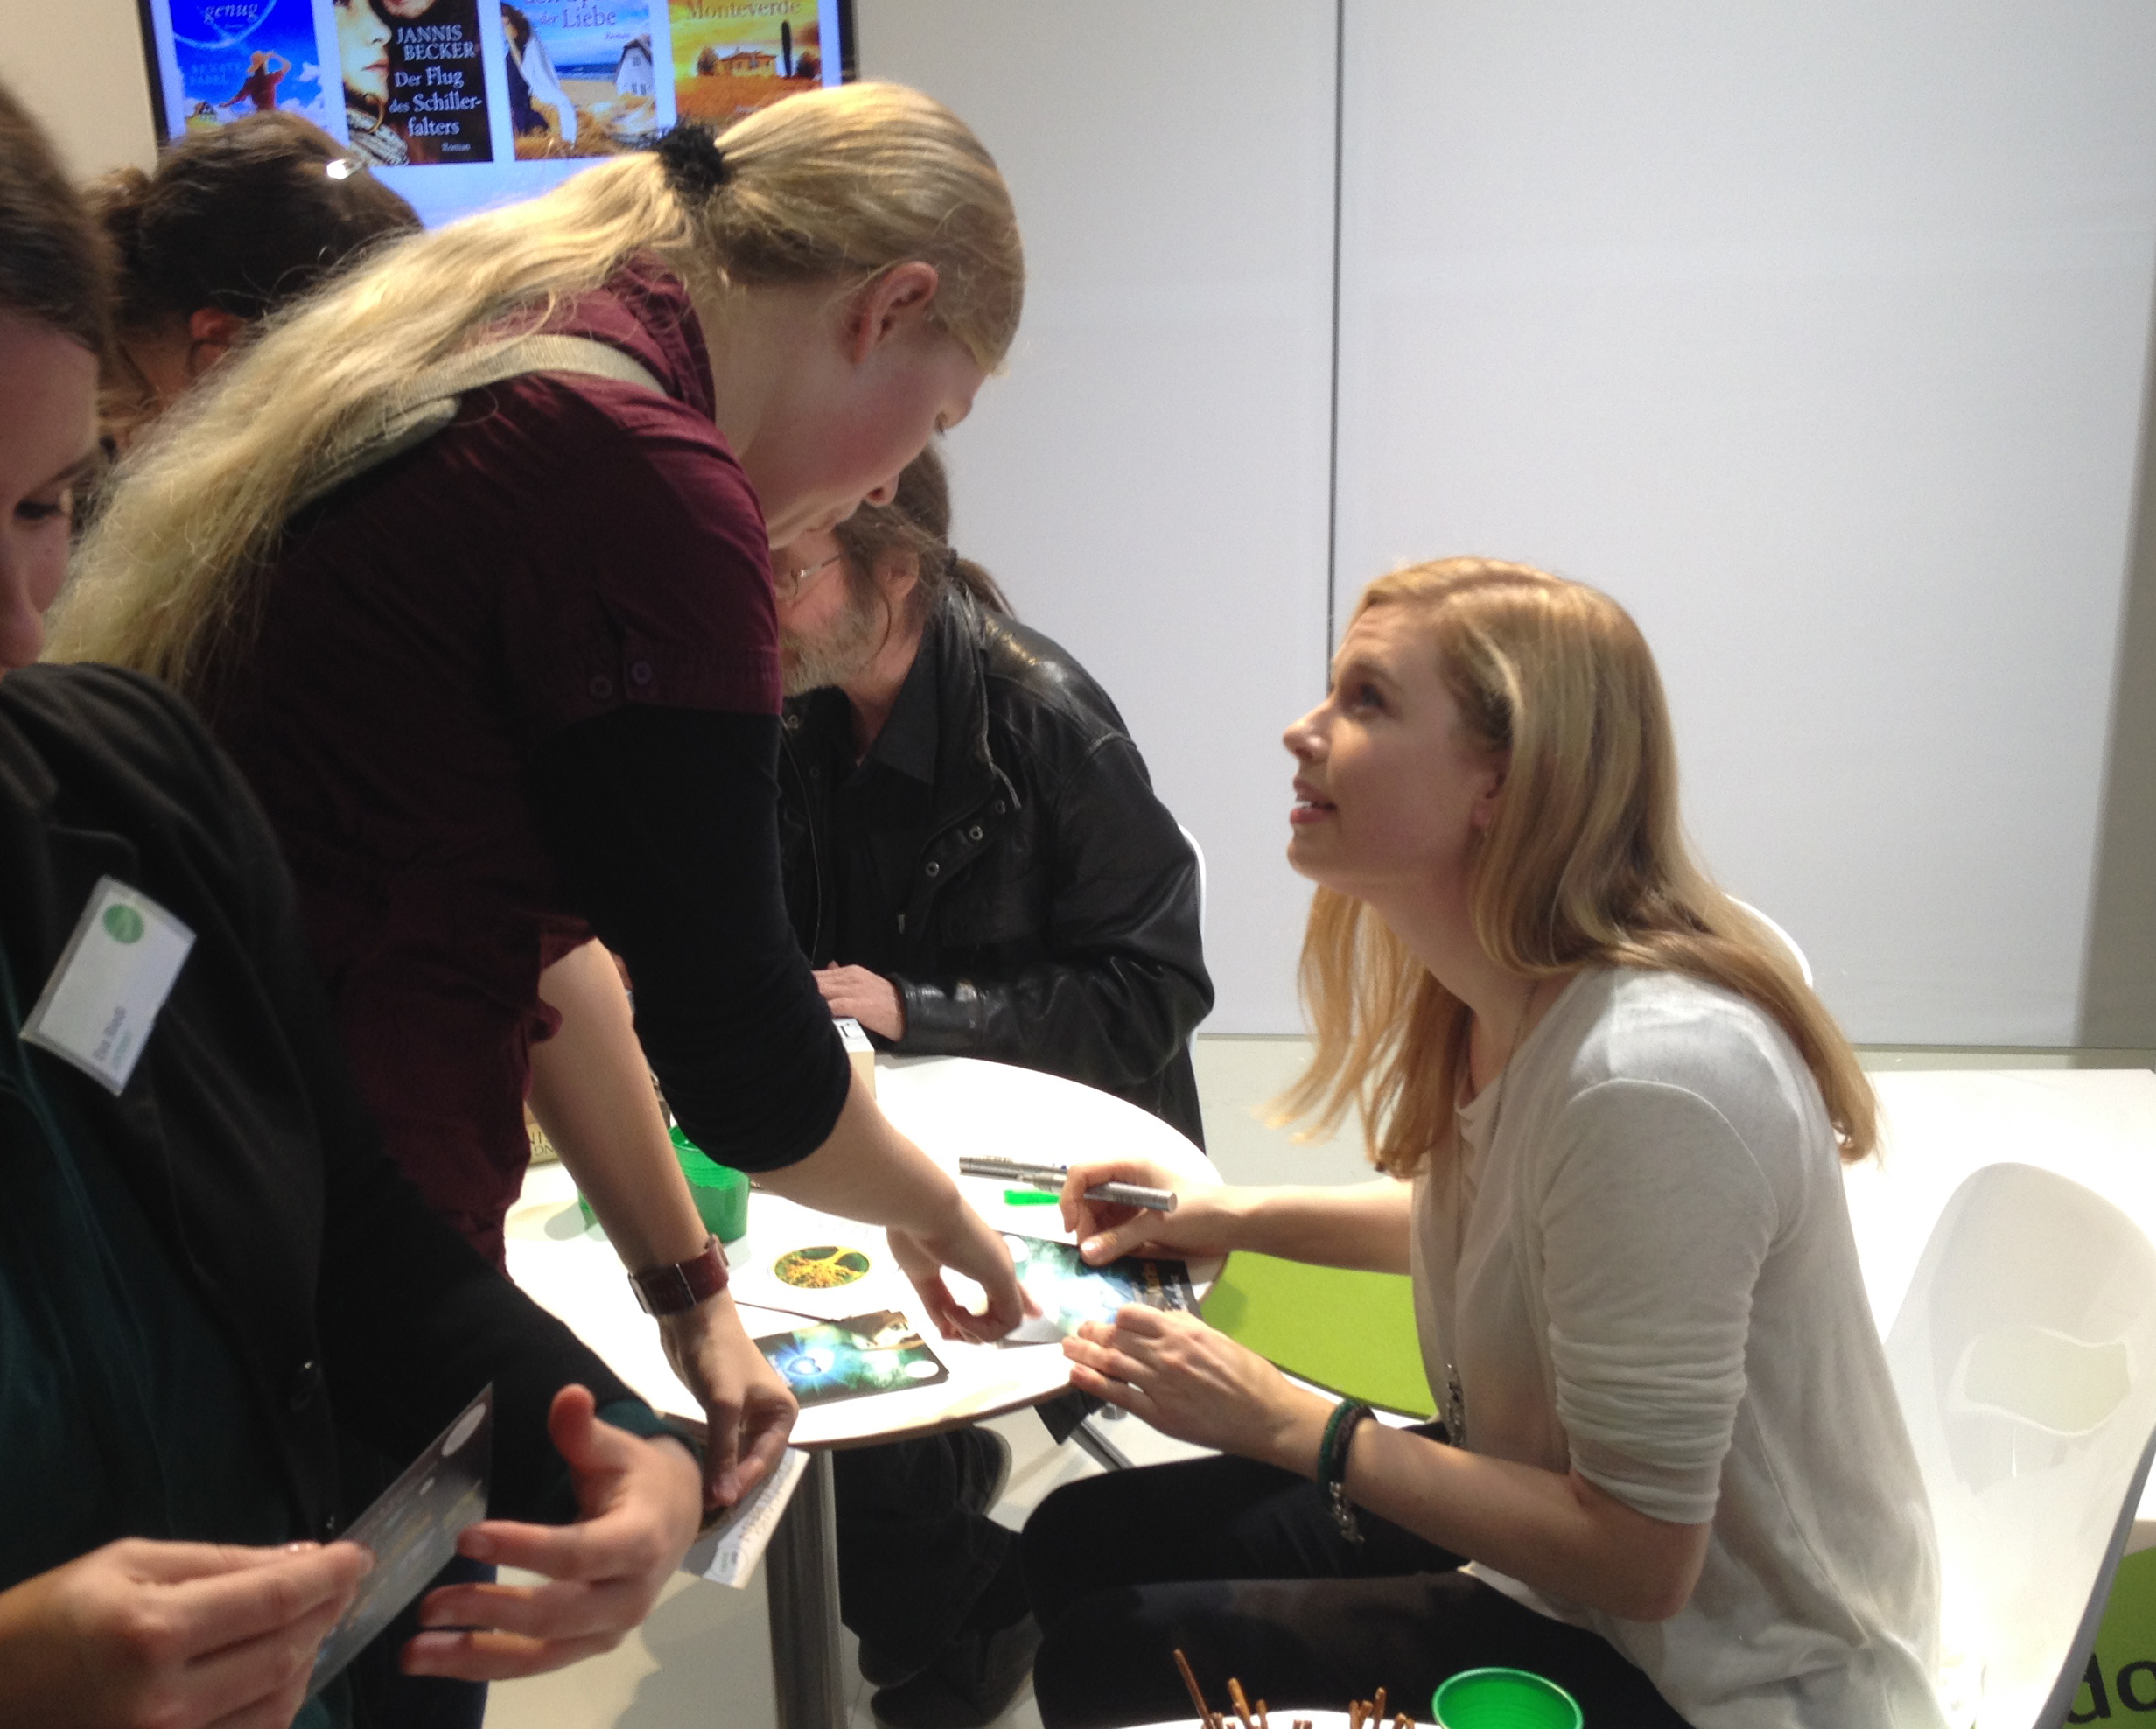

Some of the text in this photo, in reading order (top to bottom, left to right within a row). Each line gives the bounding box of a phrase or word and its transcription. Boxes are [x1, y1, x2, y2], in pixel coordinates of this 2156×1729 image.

[204, 4, 259, 24] genug
[540, 4, 617, 28] der Liebe
[686, 0, 802, 20] Monteverde
[396, 24, 463, 45] JANNIS
[403, 41, 476, 61] BECKER
[394, 65, 465, 88] Der Flug
[388, 90, 483, 113] des Schiller-
[408, 116, 460, 136] falters
[441, 142, 471, 152] Roman
